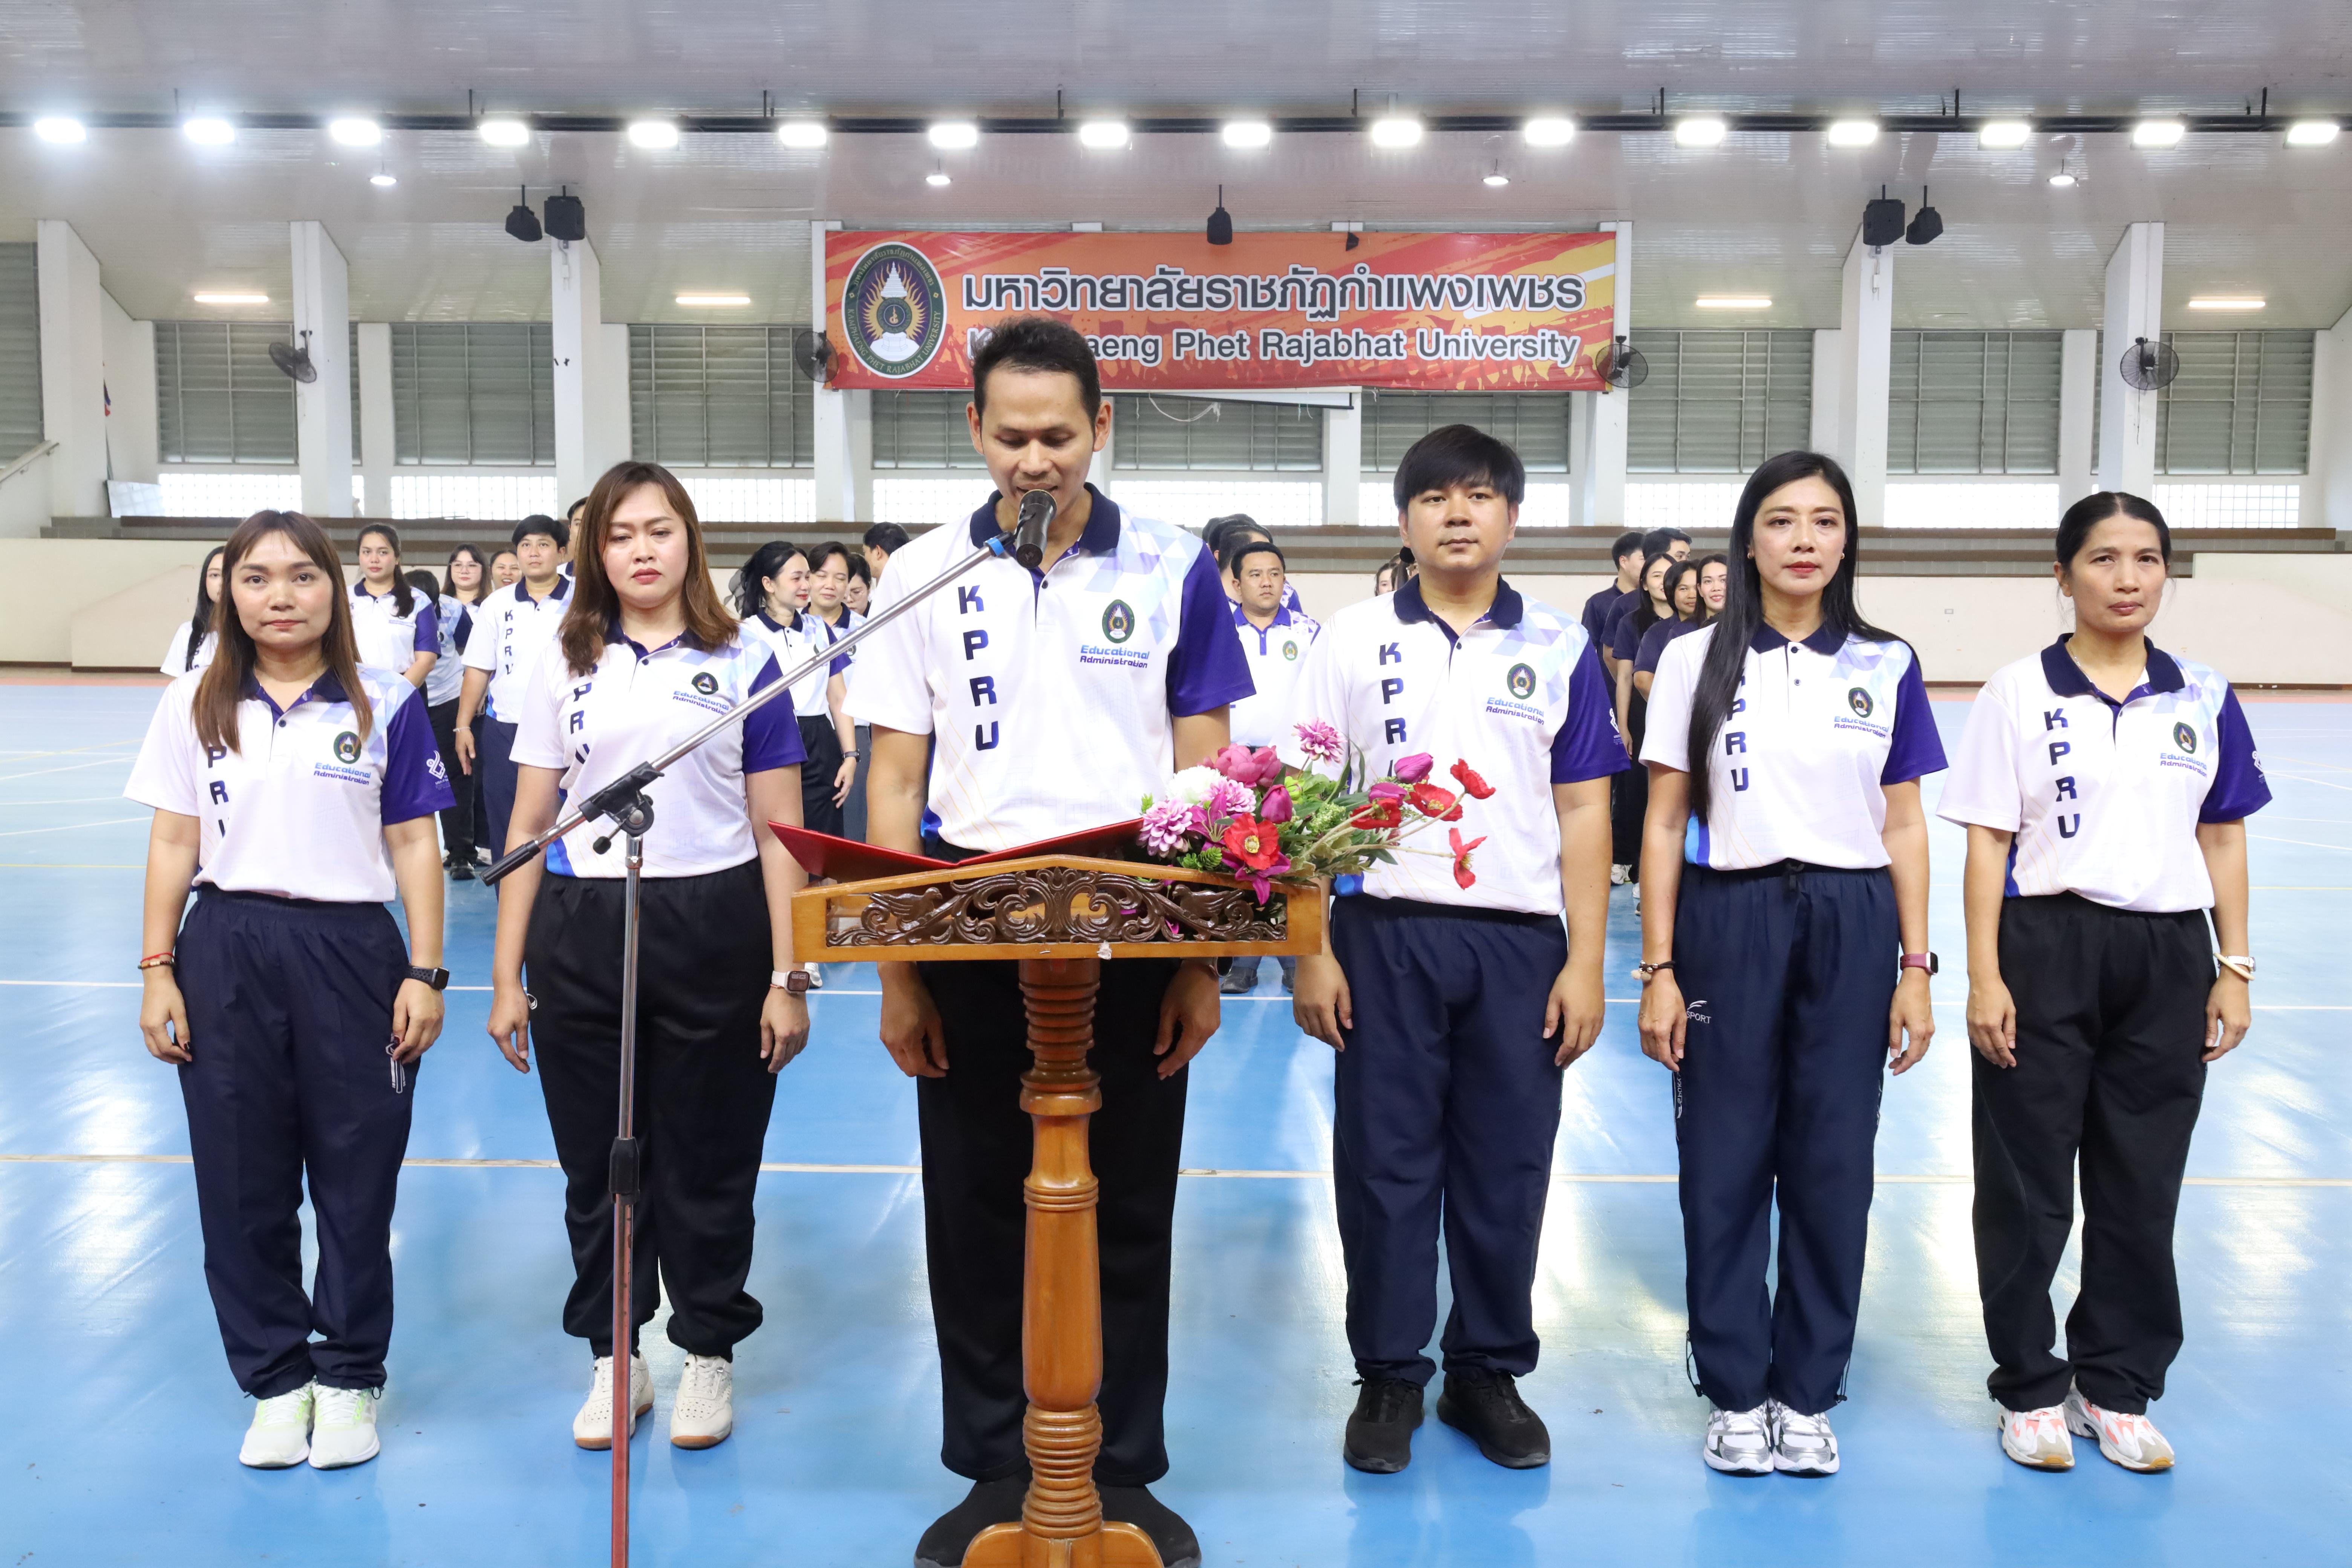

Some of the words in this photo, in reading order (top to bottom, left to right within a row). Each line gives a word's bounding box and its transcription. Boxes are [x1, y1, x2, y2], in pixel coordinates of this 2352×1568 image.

[965, 265, 1583, 319] มหาวิทยาลัยราชภัฏกำแพงเพชร
[848, 309, 868, 356] KAMPHAENG
[867, 356, 885, 370] PHET
[887, 355, 924, 374] RAJABHAT
[923, 311, 941, 356] UNIVERSITY
[970, 331, 1159, 364] Kaeng
[1175, 331, 1248, 357] Phet
[1262, 331, 1404, 364] Rajabhat
[1419, 331, 1578, 364] University
[1080, 645, 1150, 660] Educational
[1080, 655, 1148, 668] Administration
[957, 584, 1000, 751] KPRU
[672, 696, 727, 716] Administratio
[673, 691, 729, 710] Educational
[1487, 697, 1544, 718] Educational
[1486, 706, 1545, 725] Administration
[1834, 716, 1890, 733] Educational
[1725, 669, 1749, 792] PRU
[1834, 723, 1886, 739] Administration
[314, 762, 371, 778] Educational
[2160, 753, 2207, 771] Educationa
[313, 770, 369, 786] Administration
[2044, 708, 2081, 839] KPRU
[1686, 1010, 1712, 1024] SPORT
